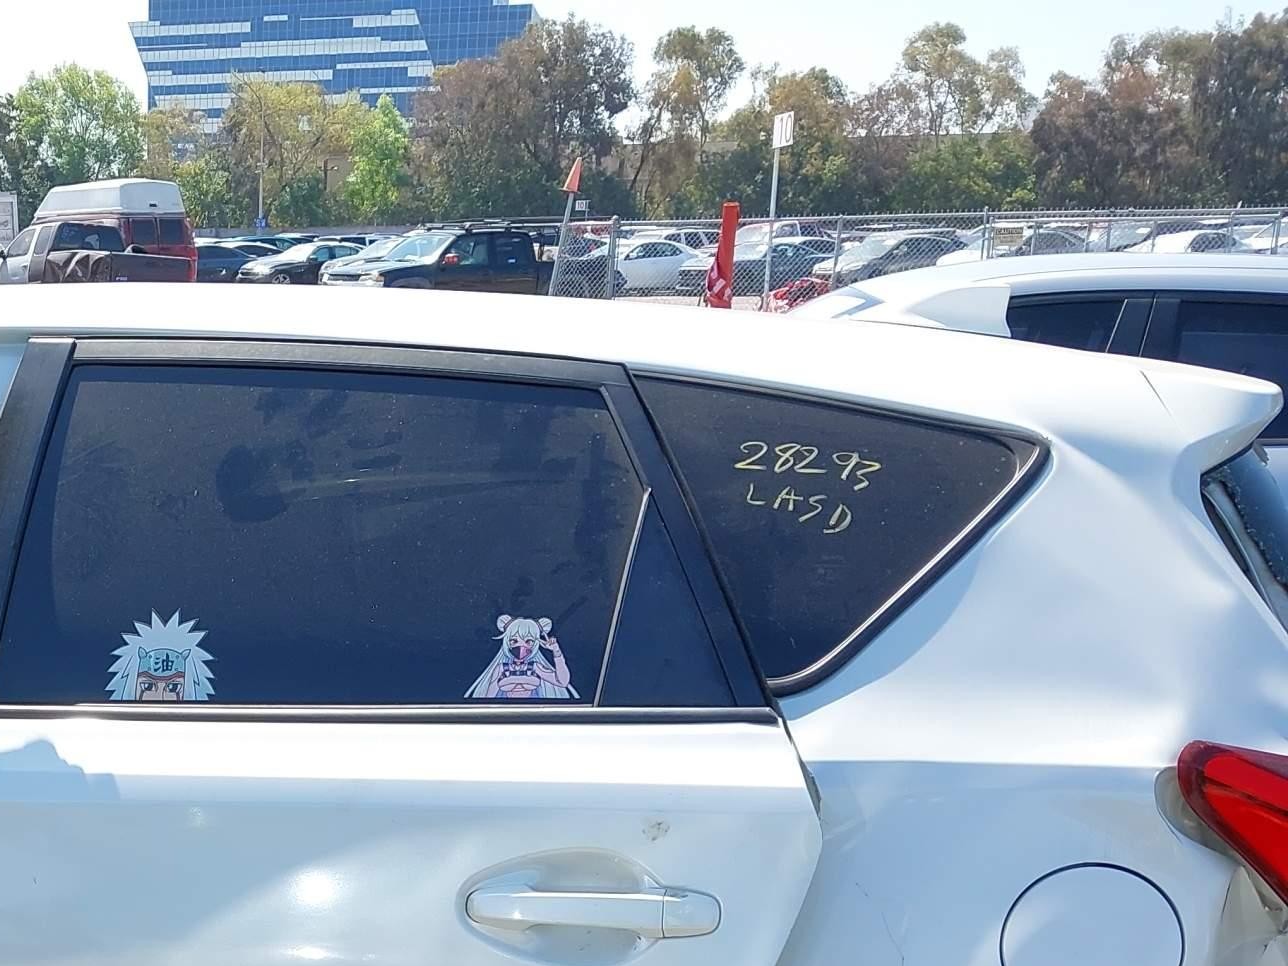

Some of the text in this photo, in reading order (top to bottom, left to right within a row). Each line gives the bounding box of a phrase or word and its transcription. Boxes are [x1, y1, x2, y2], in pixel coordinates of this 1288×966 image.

[778, 113, 793, 145] 10
[733, 441, 882, 491] 28293
[746, 482, 852, 534] LASD
[153, 652, 174, 672] 油
